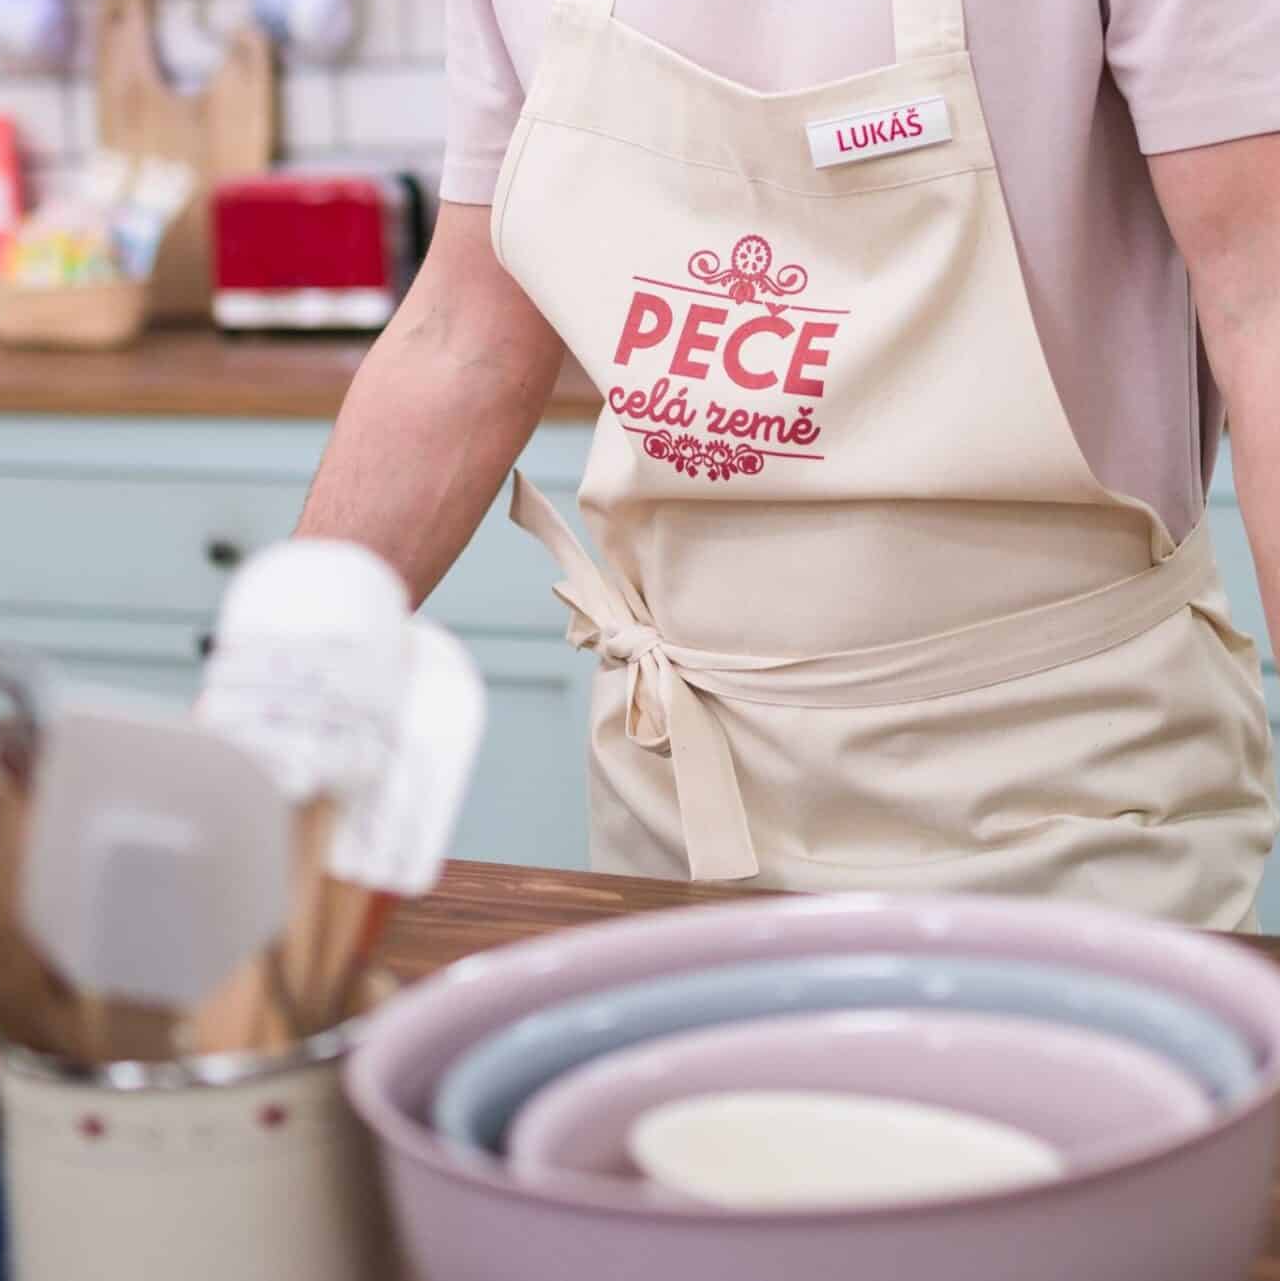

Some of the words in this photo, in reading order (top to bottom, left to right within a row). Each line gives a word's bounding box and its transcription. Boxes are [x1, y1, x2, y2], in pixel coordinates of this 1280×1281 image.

[835, 107, 924, 154] LUKÁŠ
[613, 290, 840, 399] PEČE
[607, 376, 699, 430] celá
[705, 401, 822, 448] země
